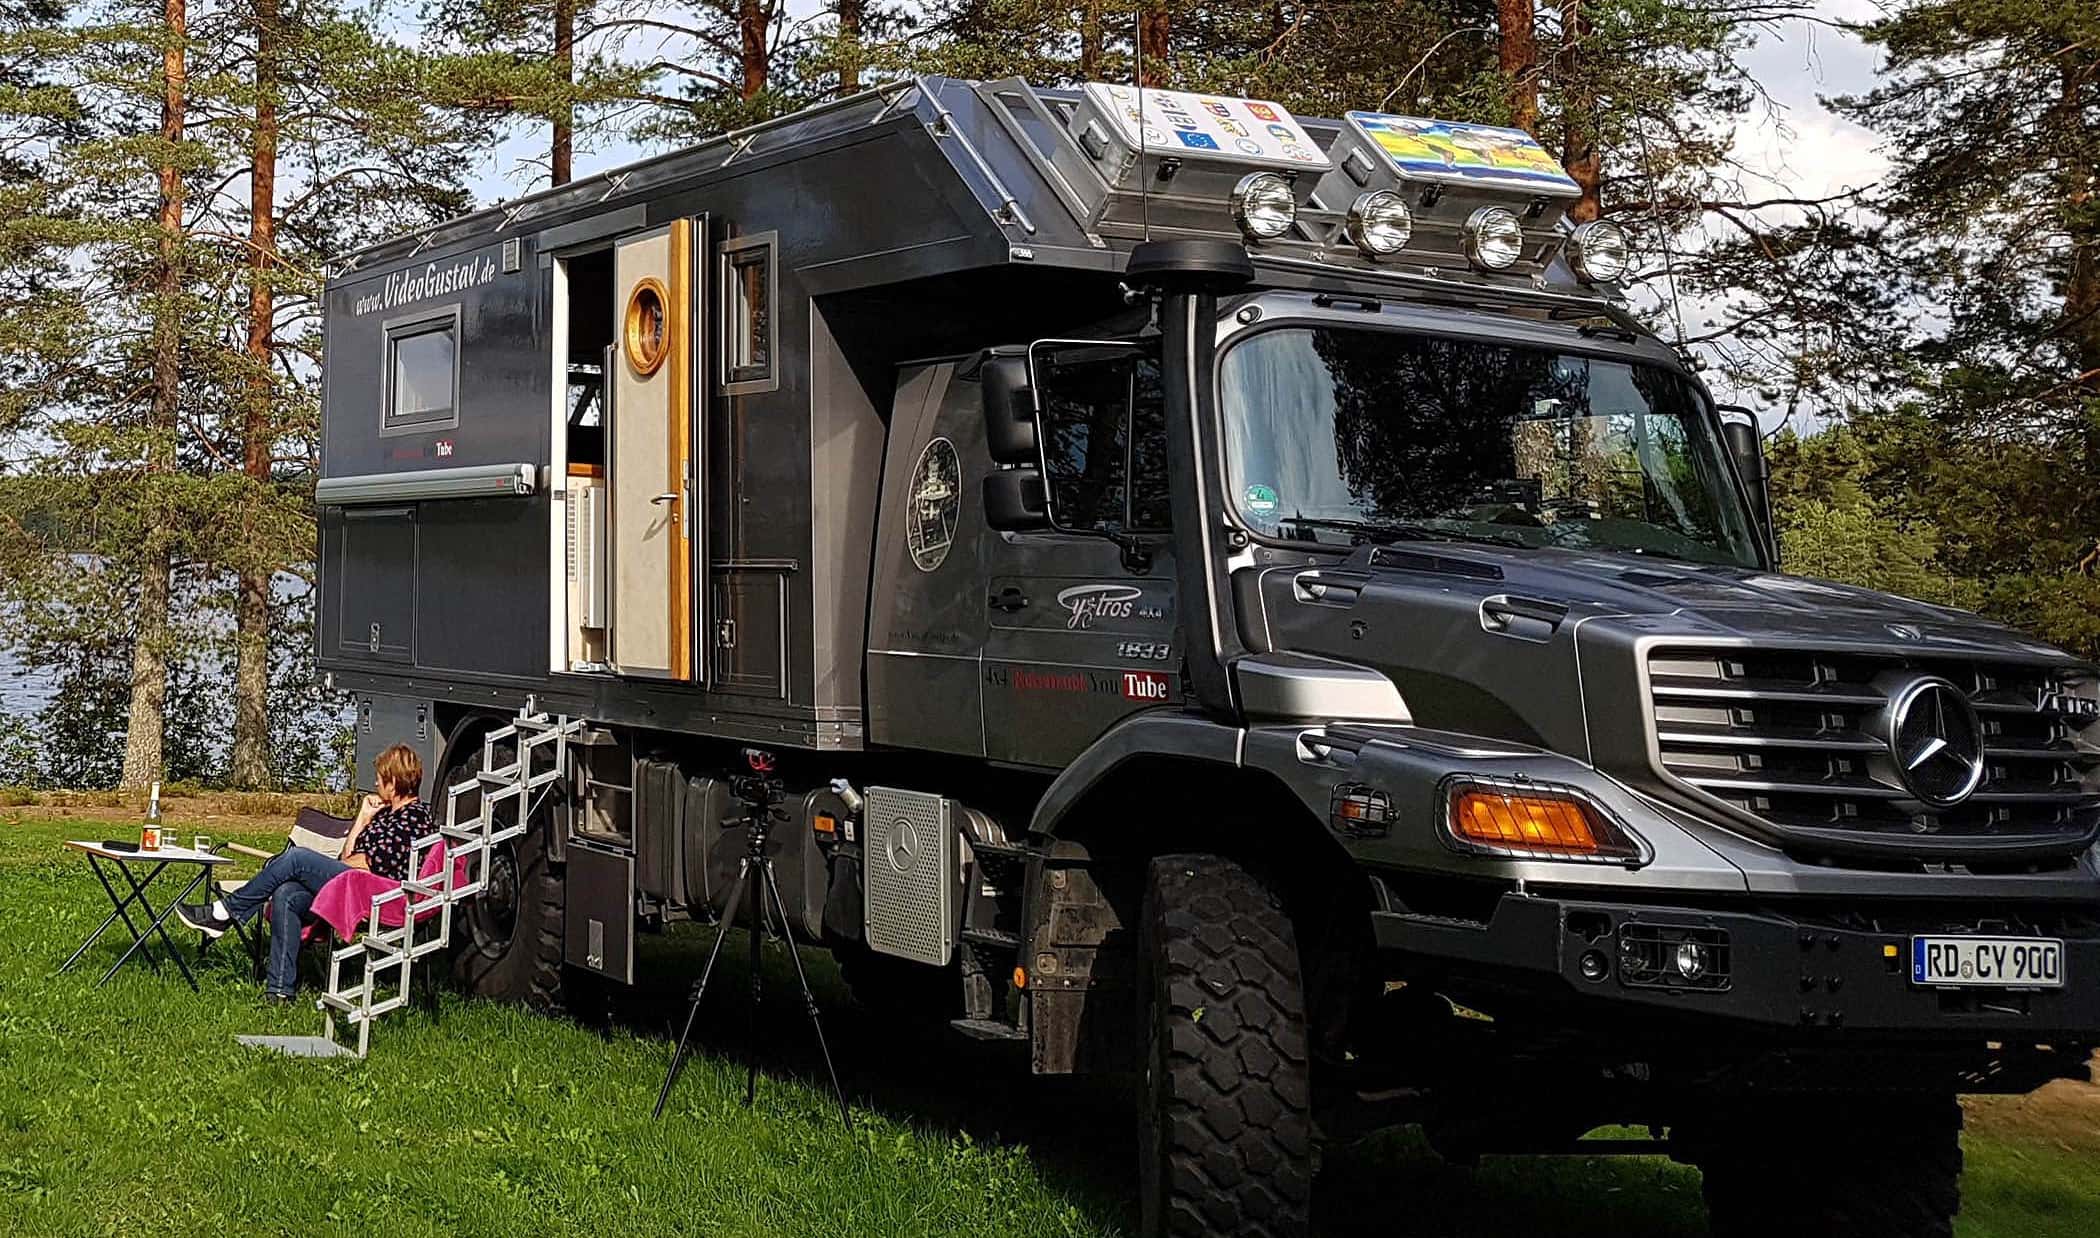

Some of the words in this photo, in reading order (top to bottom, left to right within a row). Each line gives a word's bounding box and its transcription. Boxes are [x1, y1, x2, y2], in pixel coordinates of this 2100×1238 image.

[355, 255, 496, 316] www.VideoGustav.de
[1117, 641, 1170, 660] 1833
[1124, 673, 1167, 698] Tube
[1927, 944, 1958, 977] RD
[1976, 945, 2007, 977] CY
[2013, 946, 2057, 979] 900
